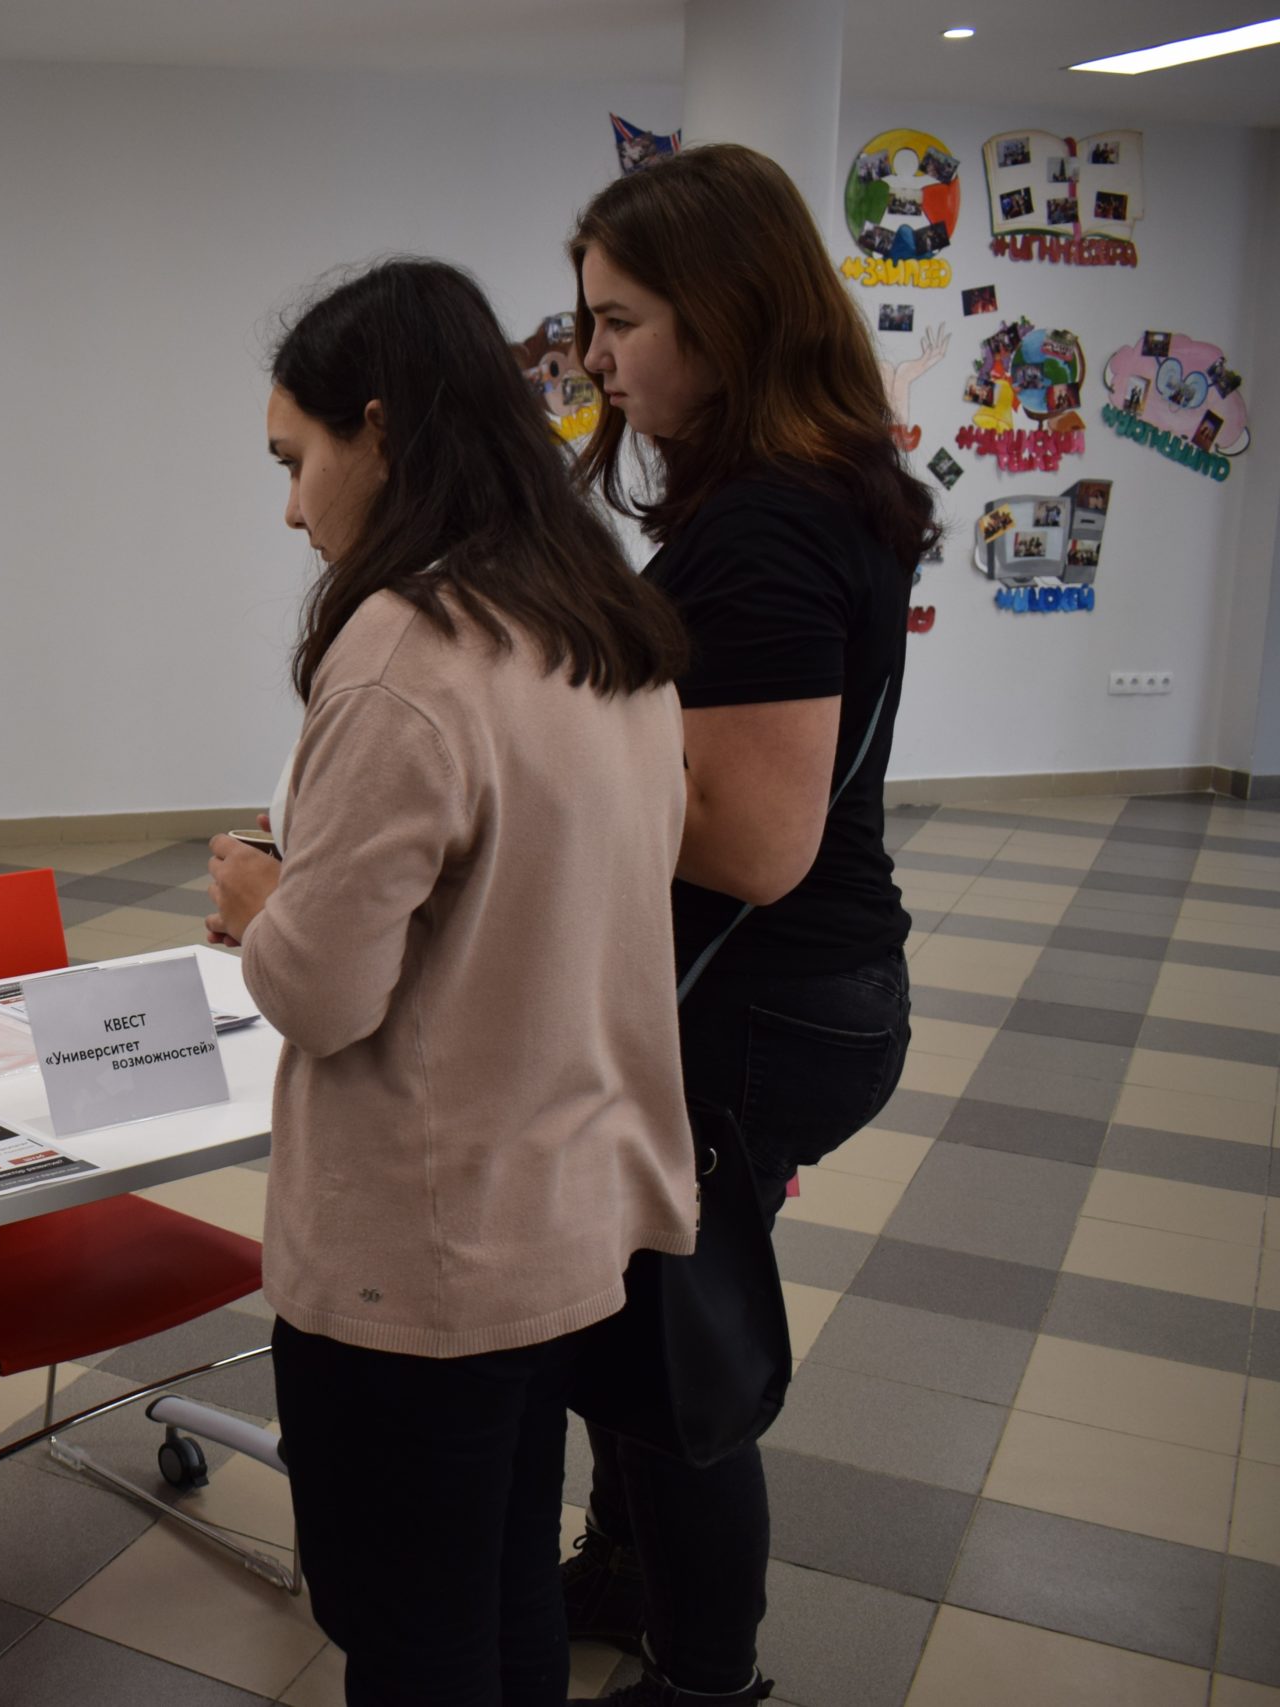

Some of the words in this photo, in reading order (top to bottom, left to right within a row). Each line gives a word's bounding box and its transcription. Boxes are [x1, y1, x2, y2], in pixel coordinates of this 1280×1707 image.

[104, 1013, 147, 1033] КВЕСТ
[45, 1040, 140, 1066] «Университет
[112, 1041, 215, 1070] возможностей»
